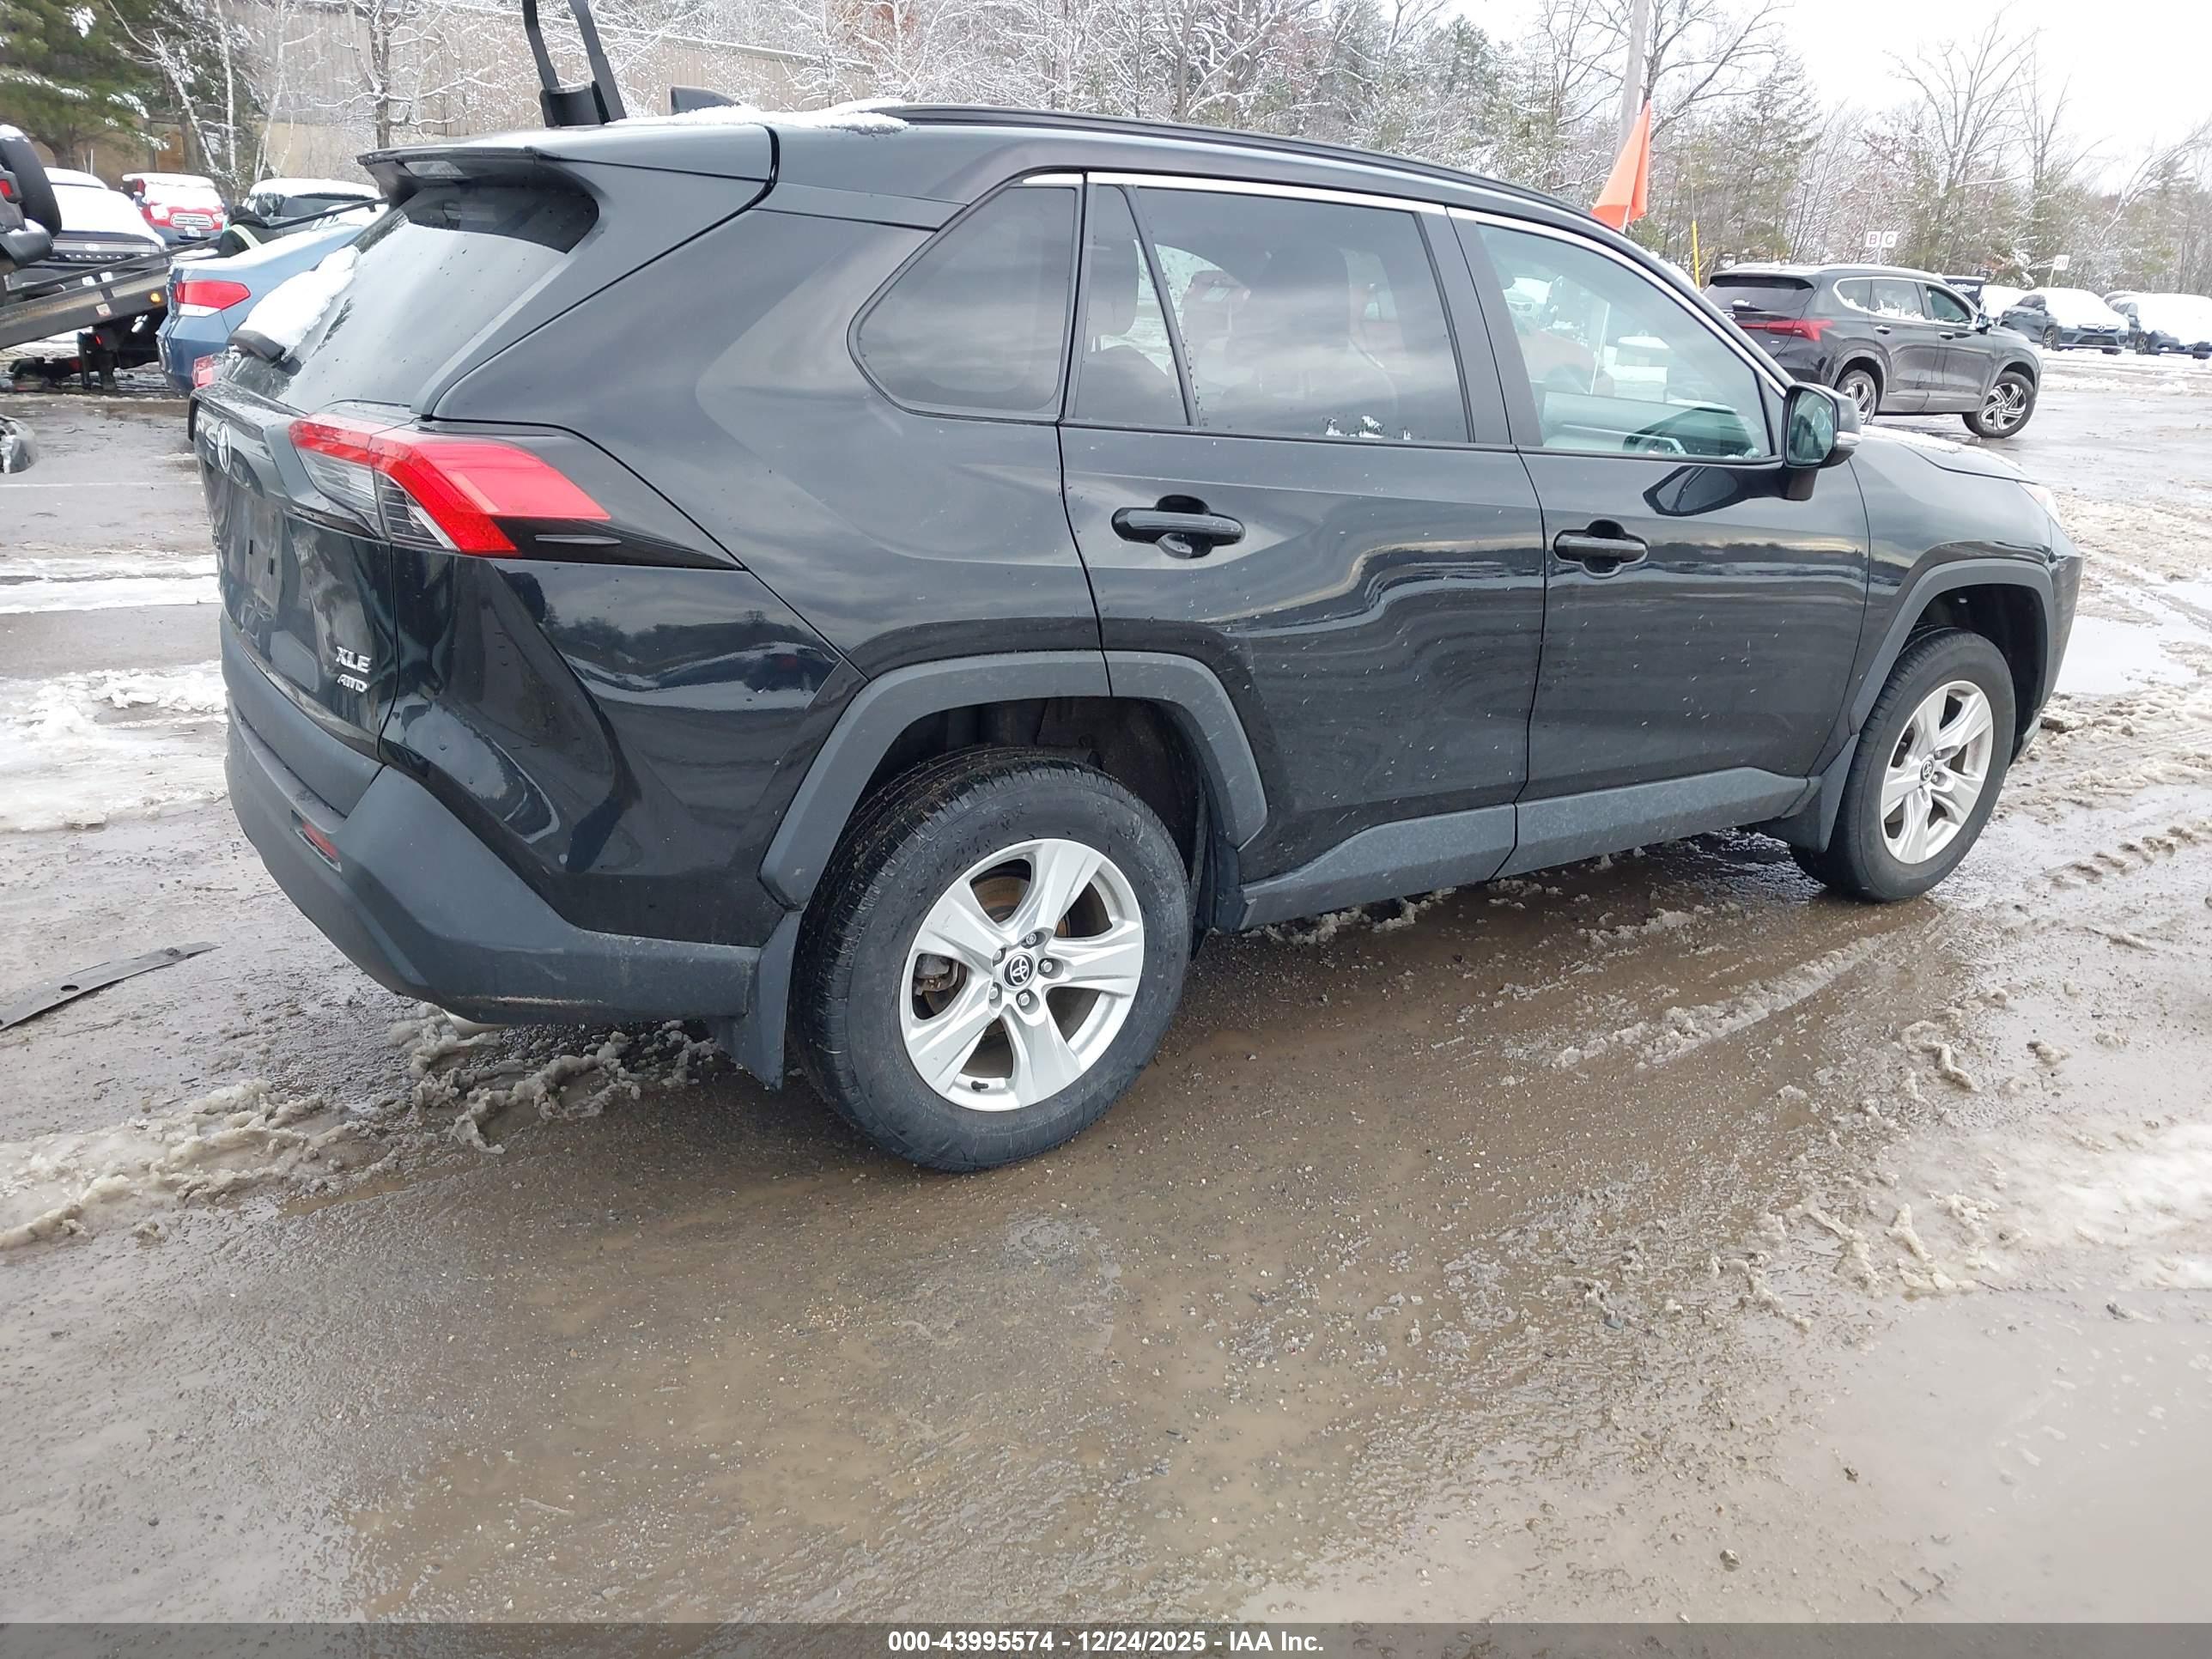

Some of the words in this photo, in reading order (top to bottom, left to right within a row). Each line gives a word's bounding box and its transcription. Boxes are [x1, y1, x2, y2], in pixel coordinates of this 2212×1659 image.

[1869, 234, 1878, 245] B
[1885, 234, 1894, 246] C
[335, 646, 372, 674] XLE
[337, 672, 368, 693] AWD
